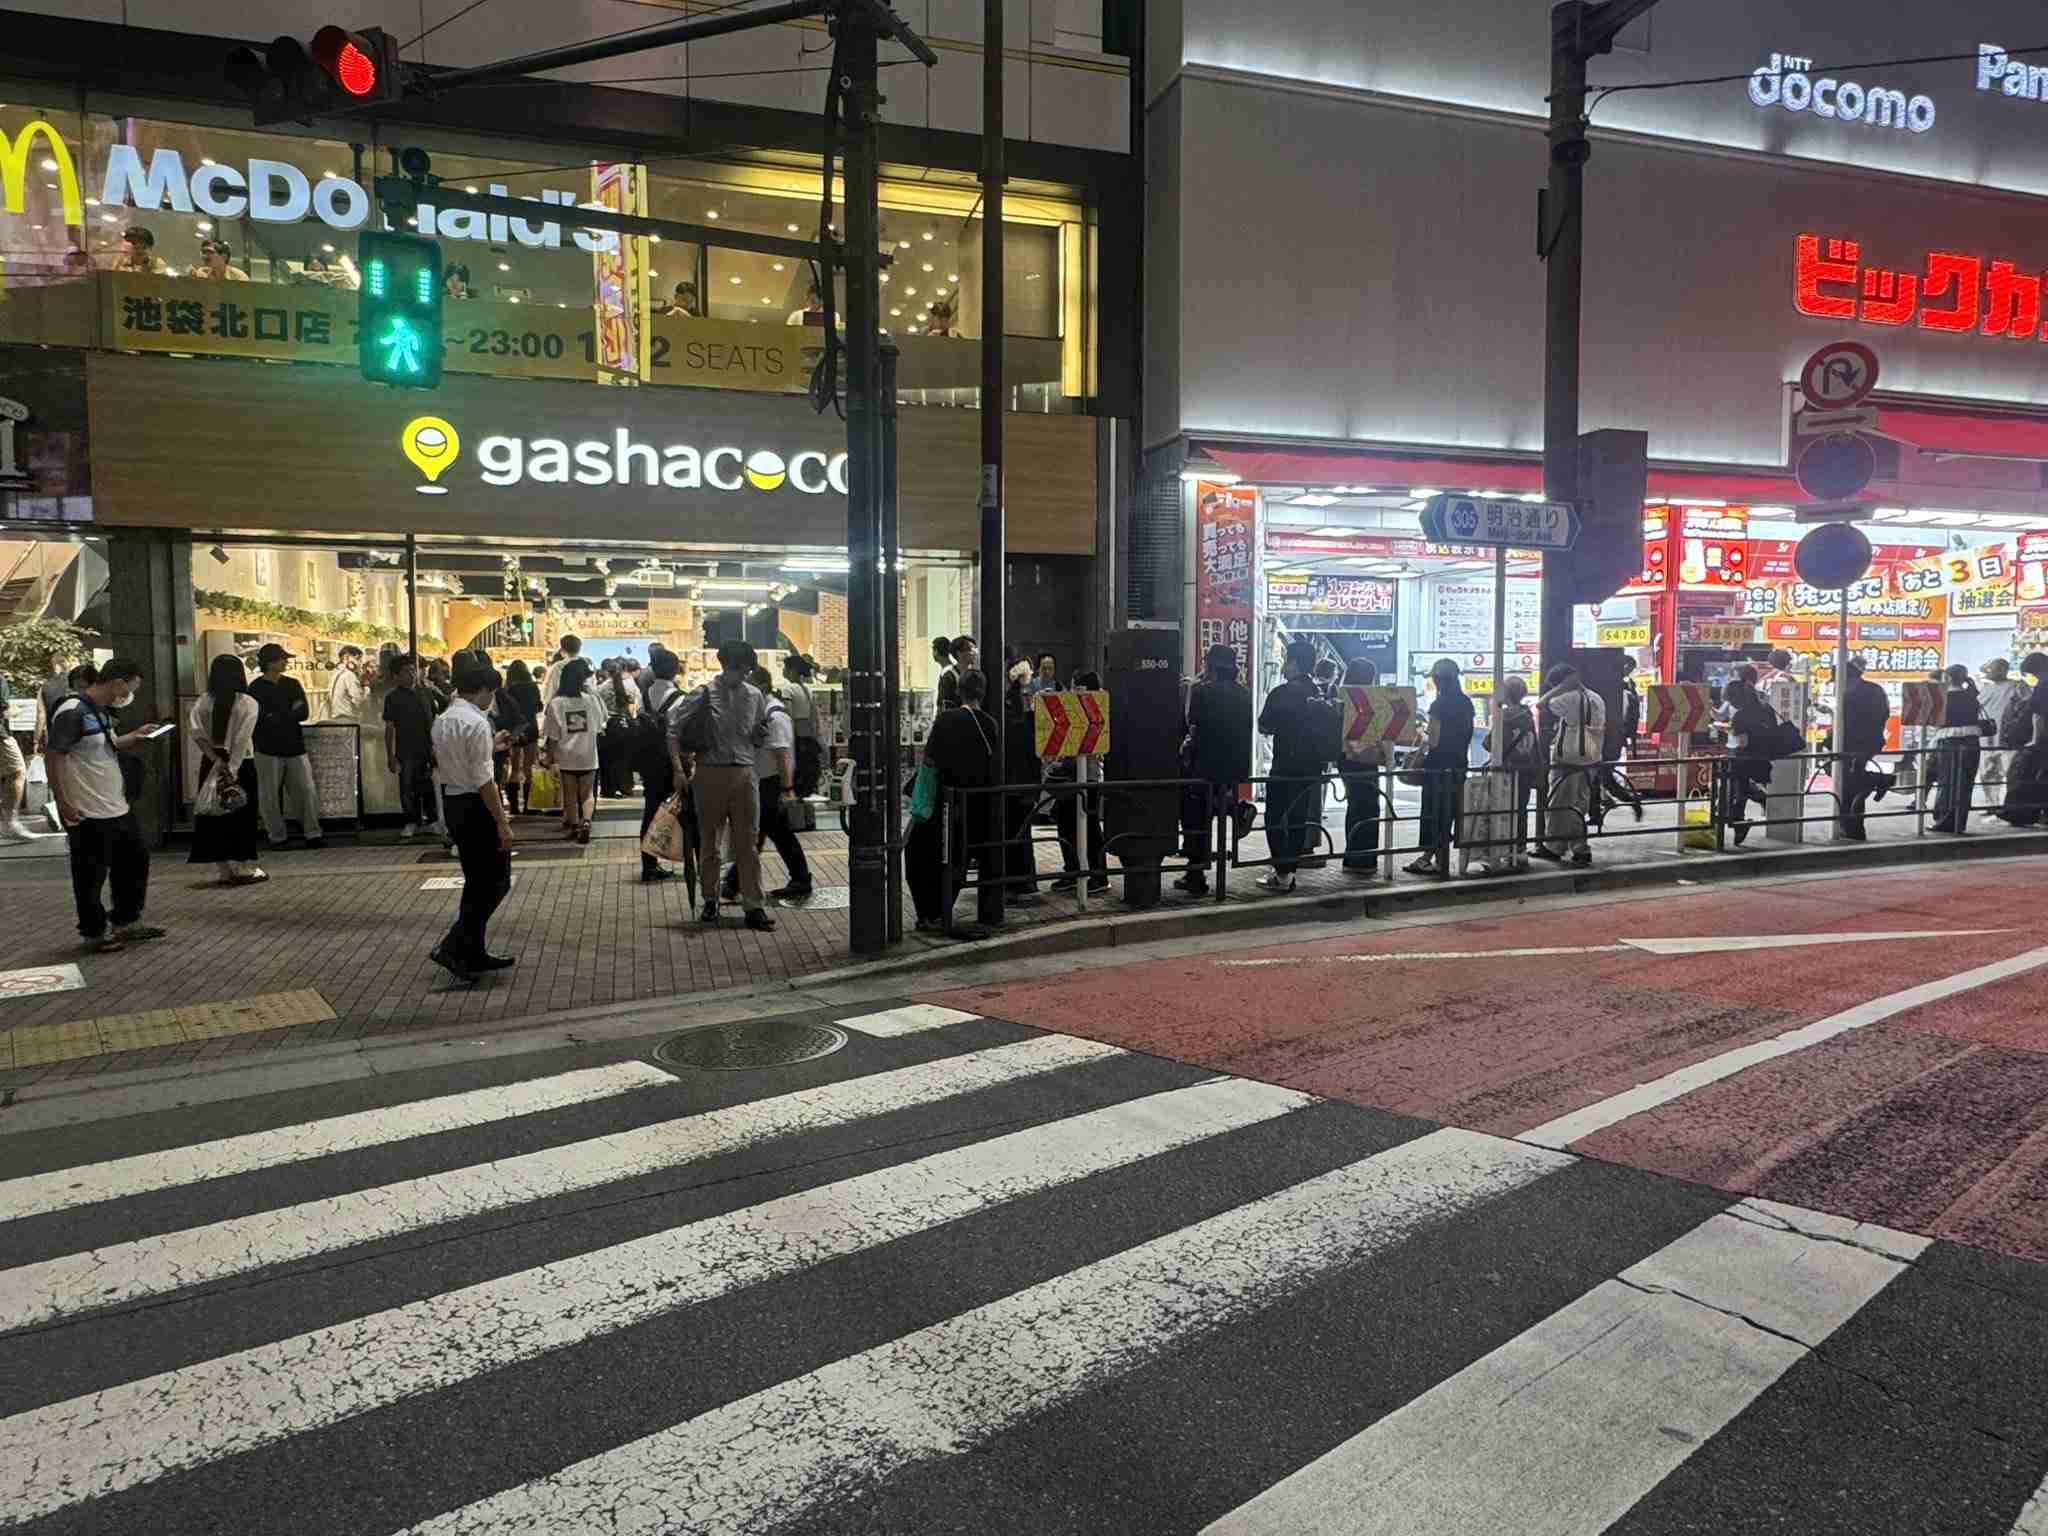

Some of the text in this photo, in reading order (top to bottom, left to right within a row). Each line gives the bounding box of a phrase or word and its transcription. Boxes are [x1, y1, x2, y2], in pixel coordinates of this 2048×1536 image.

[1784, 56, 1812, 72] NTT
[1748, 52, 1936, 133] docomo
[103, 143, 622, 251] McDoald's
[1794, 233, 2048, 342] ビックカ
[123, 296, 331, 344] 池袋北口店
[686, 341, 784, 375] SEATS
[1453, 509, 1477, 529] 305
[1487, 503, 1559, 529] 明治通り
[1902, 569, 1942, 592] あと
[1951, 559, 1971, 583] 3
[1978, 555, 2004, 580] 日
